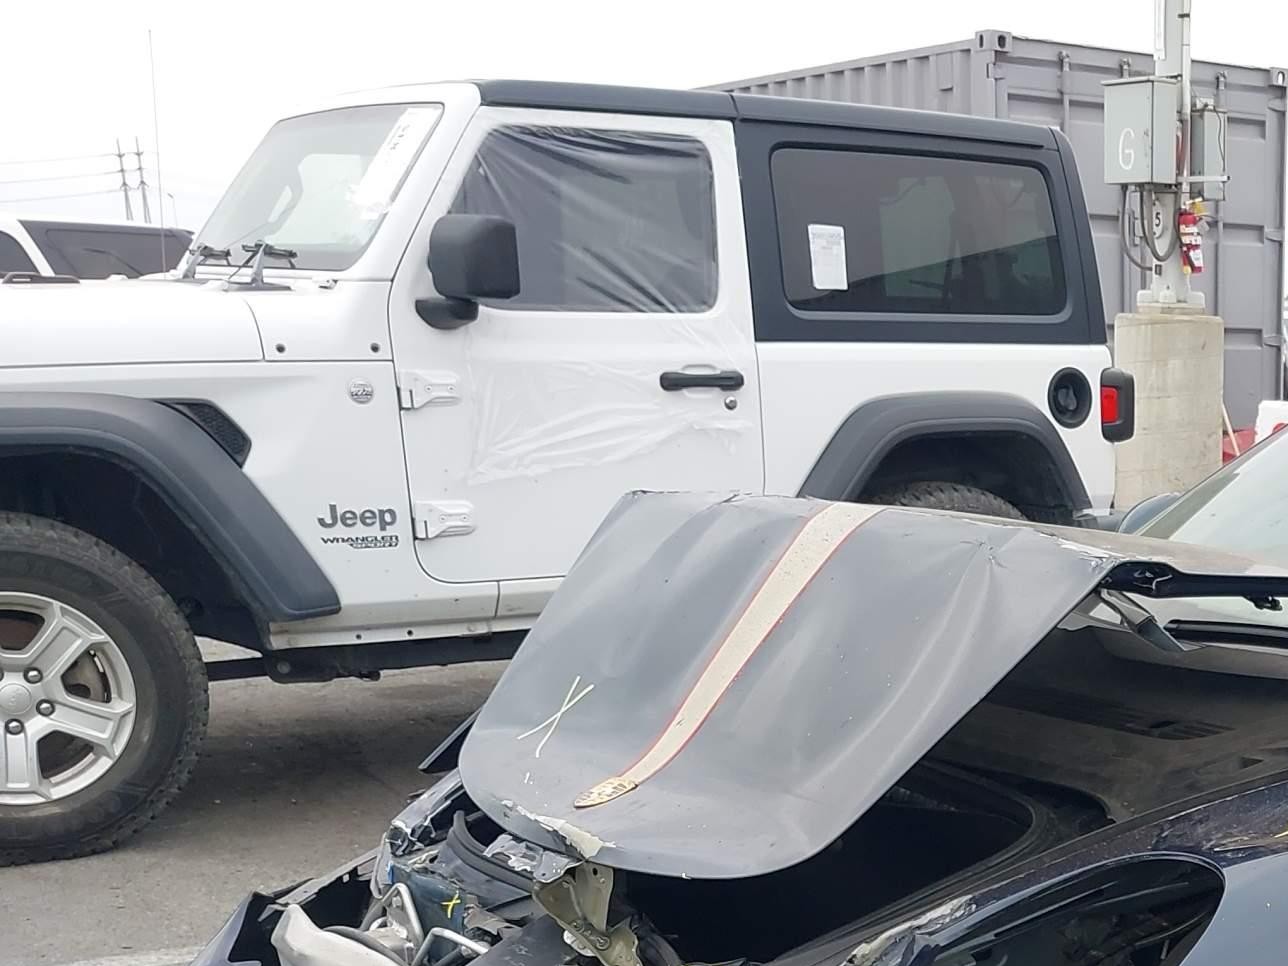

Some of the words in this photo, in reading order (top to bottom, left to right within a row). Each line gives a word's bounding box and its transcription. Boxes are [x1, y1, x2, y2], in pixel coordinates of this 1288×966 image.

[1119, 127, 1135, 170] G
[317, 503, 397, 532] Jeep
[320, 535, 399, 544] WRANGLER
